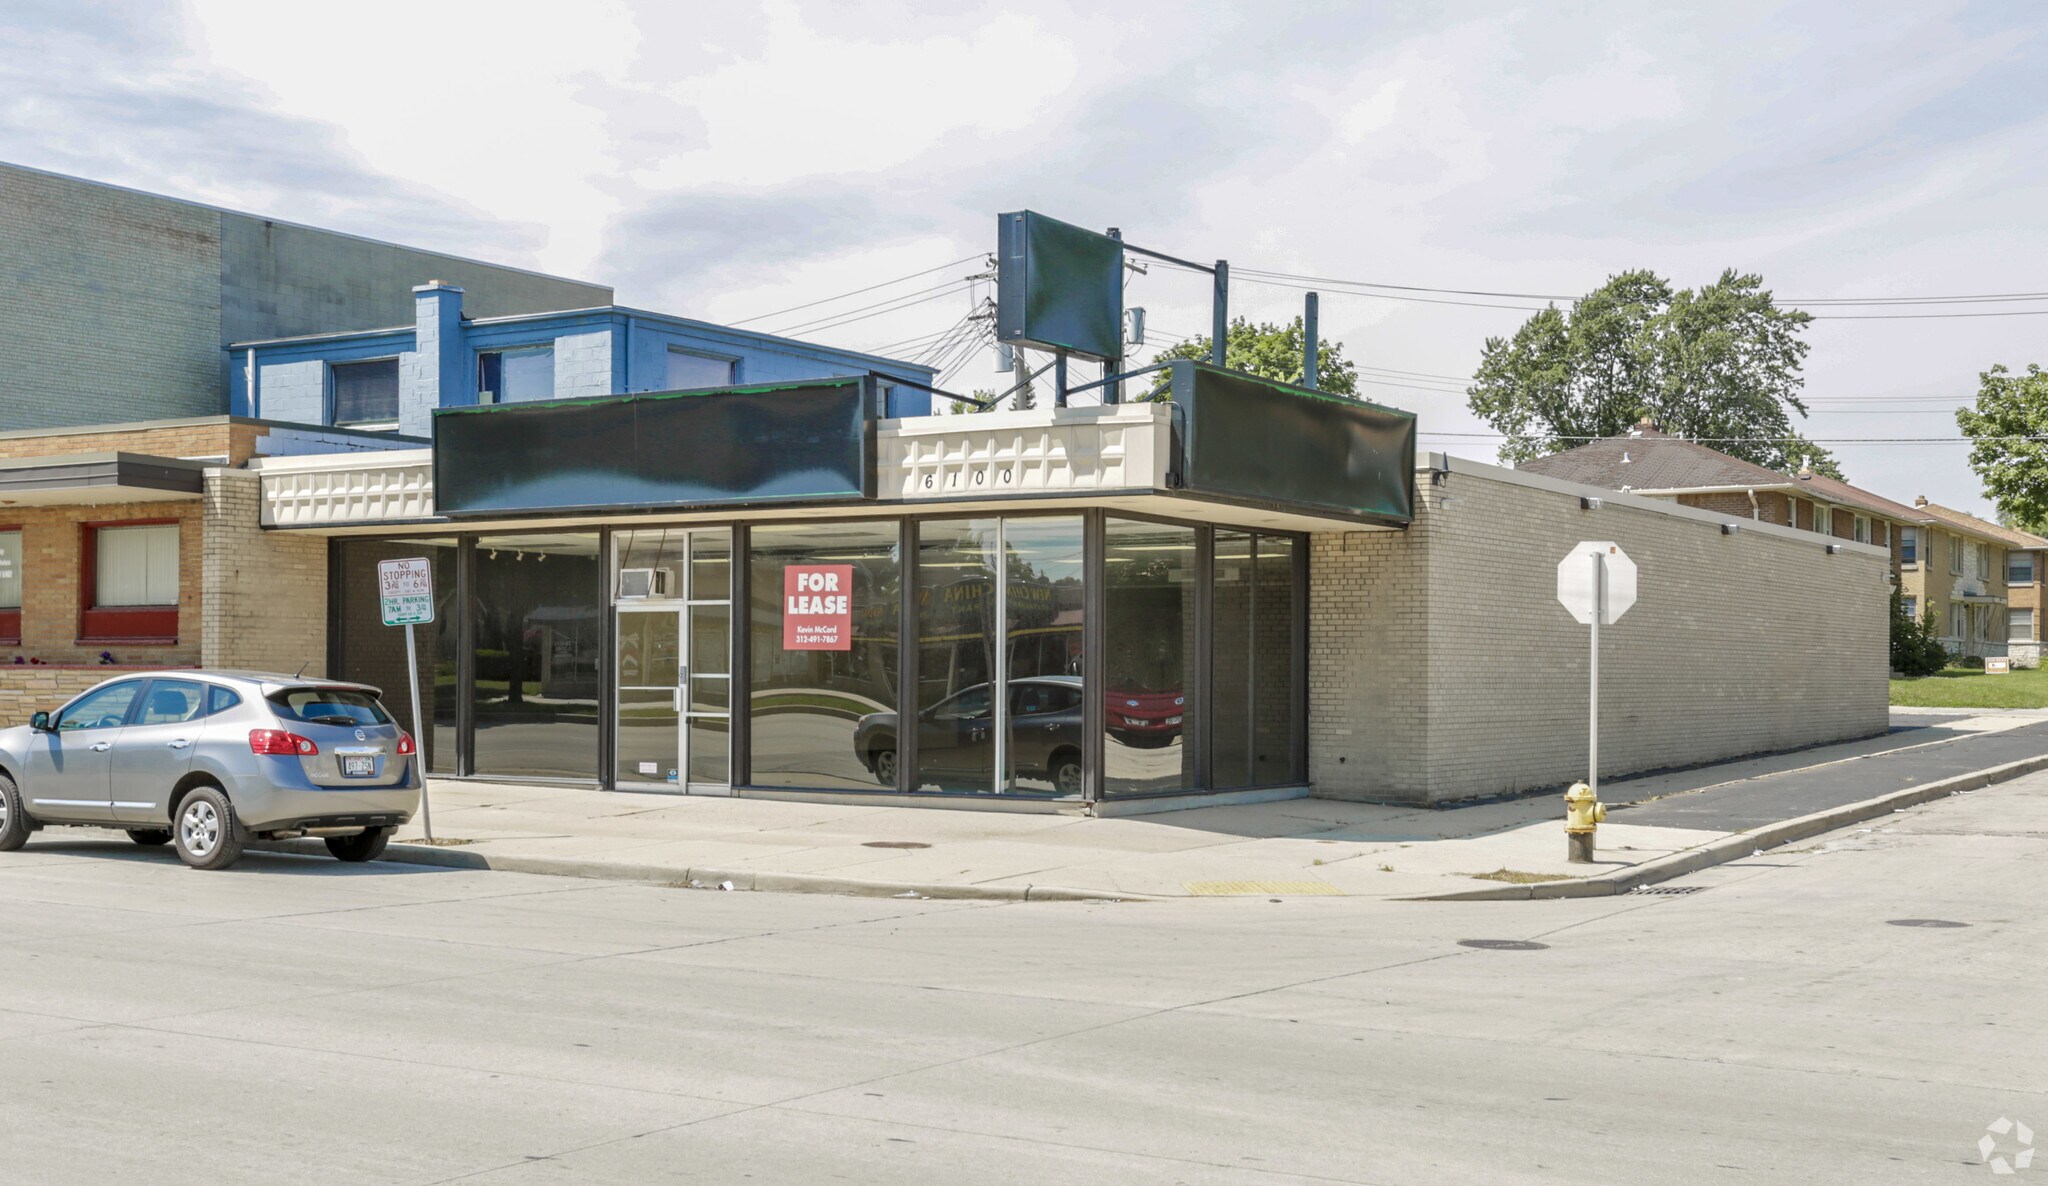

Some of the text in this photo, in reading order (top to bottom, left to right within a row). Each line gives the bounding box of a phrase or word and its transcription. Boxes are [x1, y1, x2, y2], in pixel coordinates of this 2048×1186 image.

[924, 468, 1012, 489] 6100
[383, 569, 426, 580] STOPPING
[797, 573, 839, 592] FOR
[403, 596, 430, 604] PARKING
[788, 596, 847, 614] LEASE
